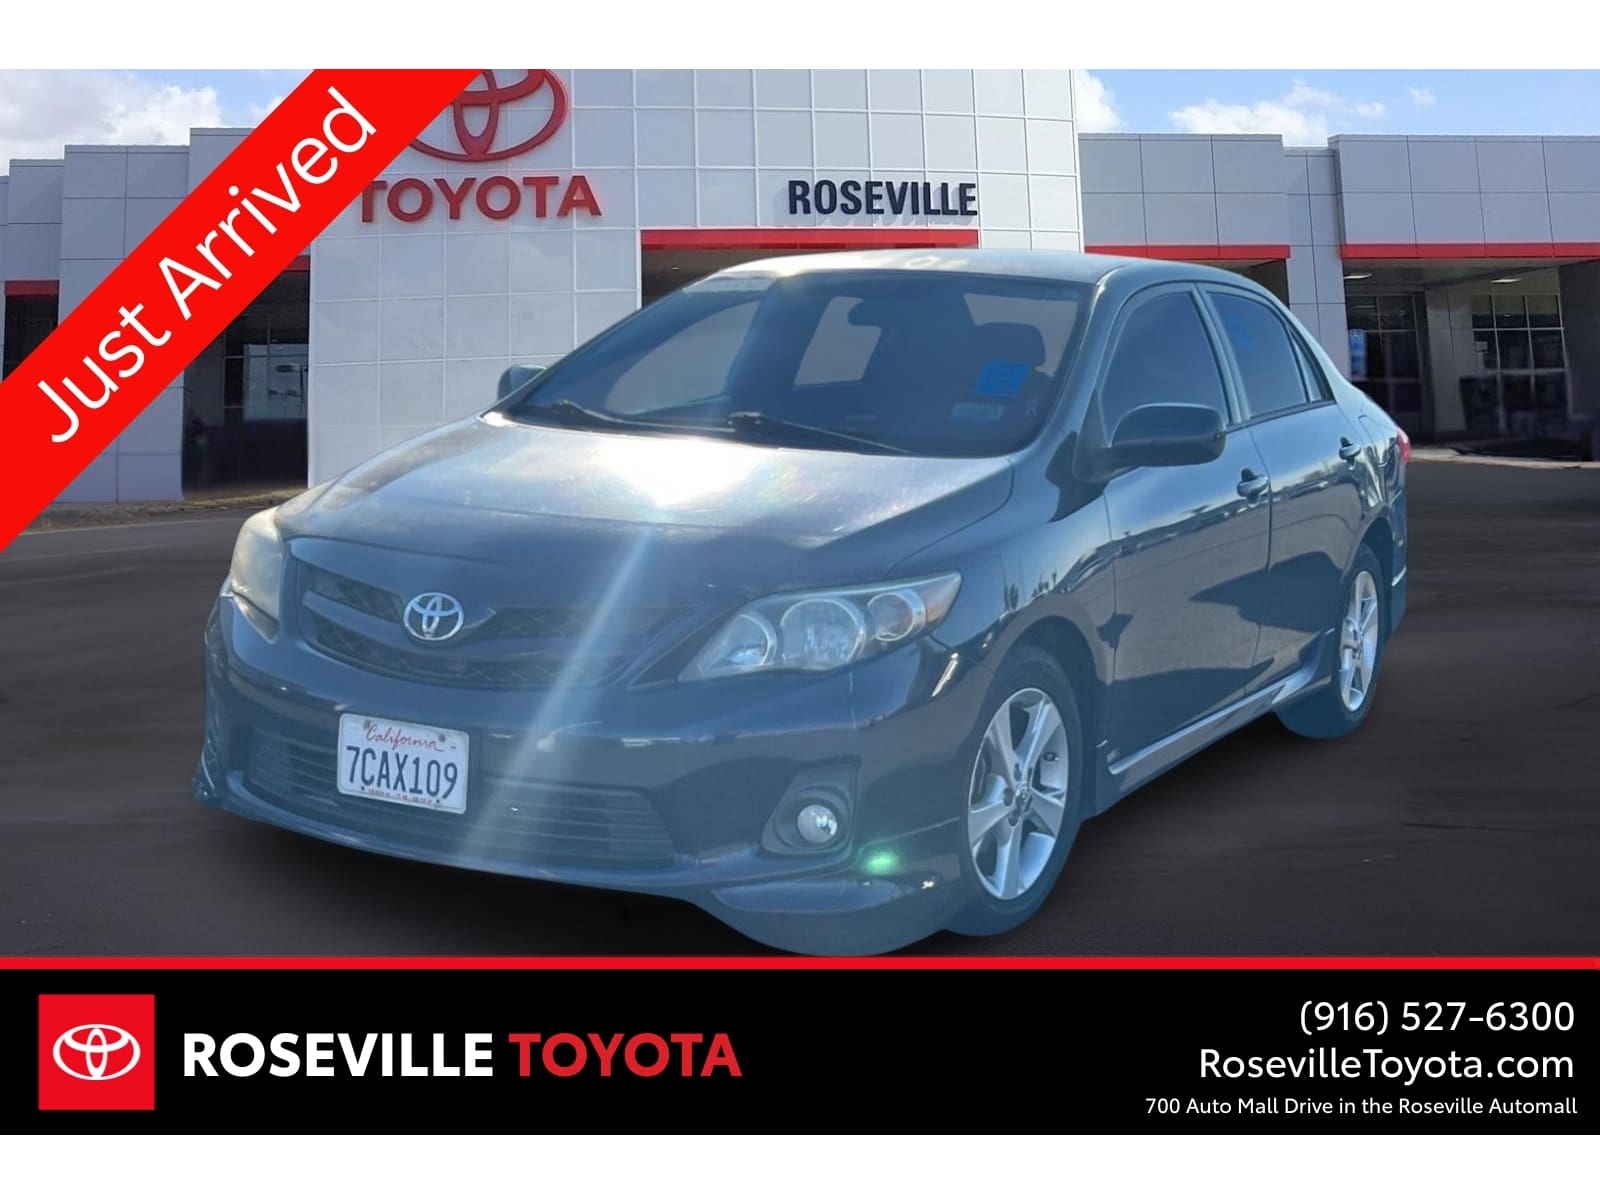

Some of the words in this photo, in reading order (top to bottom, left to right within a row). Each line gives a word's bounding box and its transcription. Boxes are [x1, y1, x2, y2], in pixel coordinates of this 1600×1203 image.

[361, 175, 602, 223] TOYOTA
[788, 179, 978, 216] ROSEVILLE
[365, 722, 445, 752] California
[345, 745, 458, 800] 7CAX109
